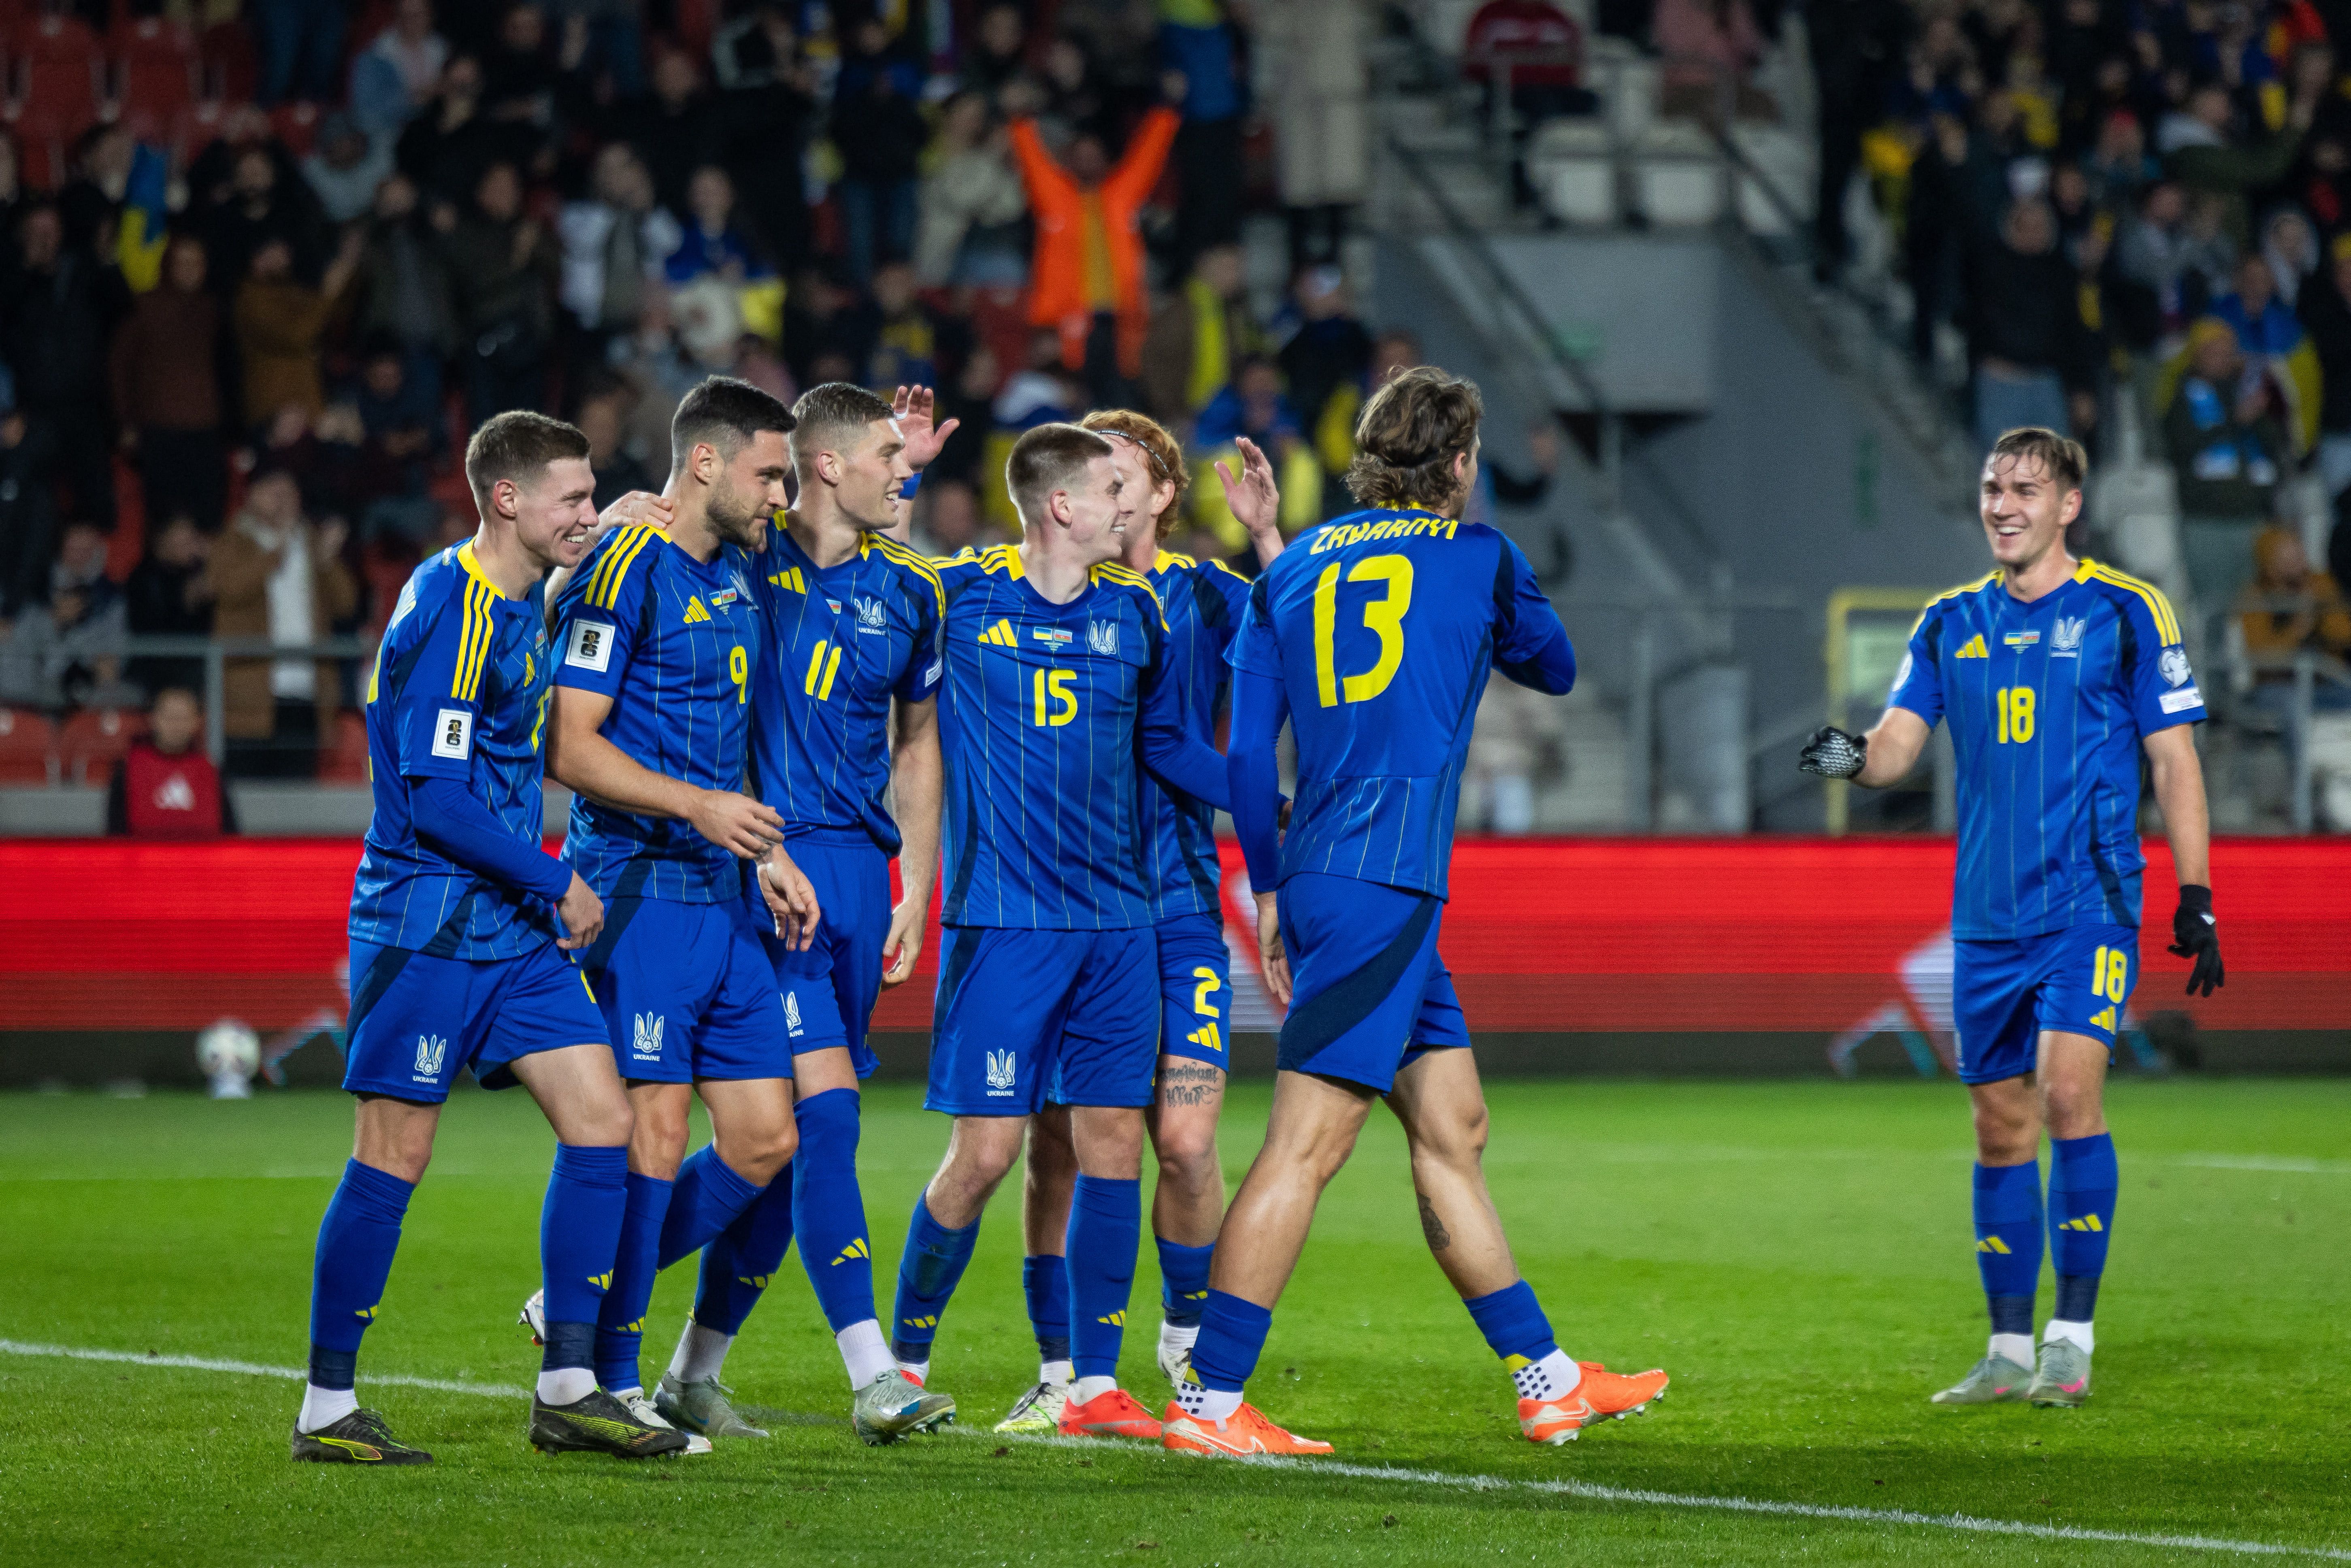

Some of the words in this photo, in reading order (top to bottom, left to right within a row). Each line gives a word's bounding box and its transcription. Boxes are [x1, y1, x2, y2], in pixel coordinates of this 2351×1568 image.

[1310, 518, 1459, 555] ZABARNYI
[858, 628, 886, 636] UKRAINE
[1313, 554, 1414, 708] 13
[729, 645, 748, 704] 9
[805, 640, 842, 701] 11
[1033, 668, 1078, 727] 15
[1997, 687, 2036, 744] 18
[1193, 966, 1221, 1018] 2
[2092, 946, 2127, 1003] 18
[789, 1029, 804, 1038] AINE
[413, 1076, 438, 1084] UKRAINE
